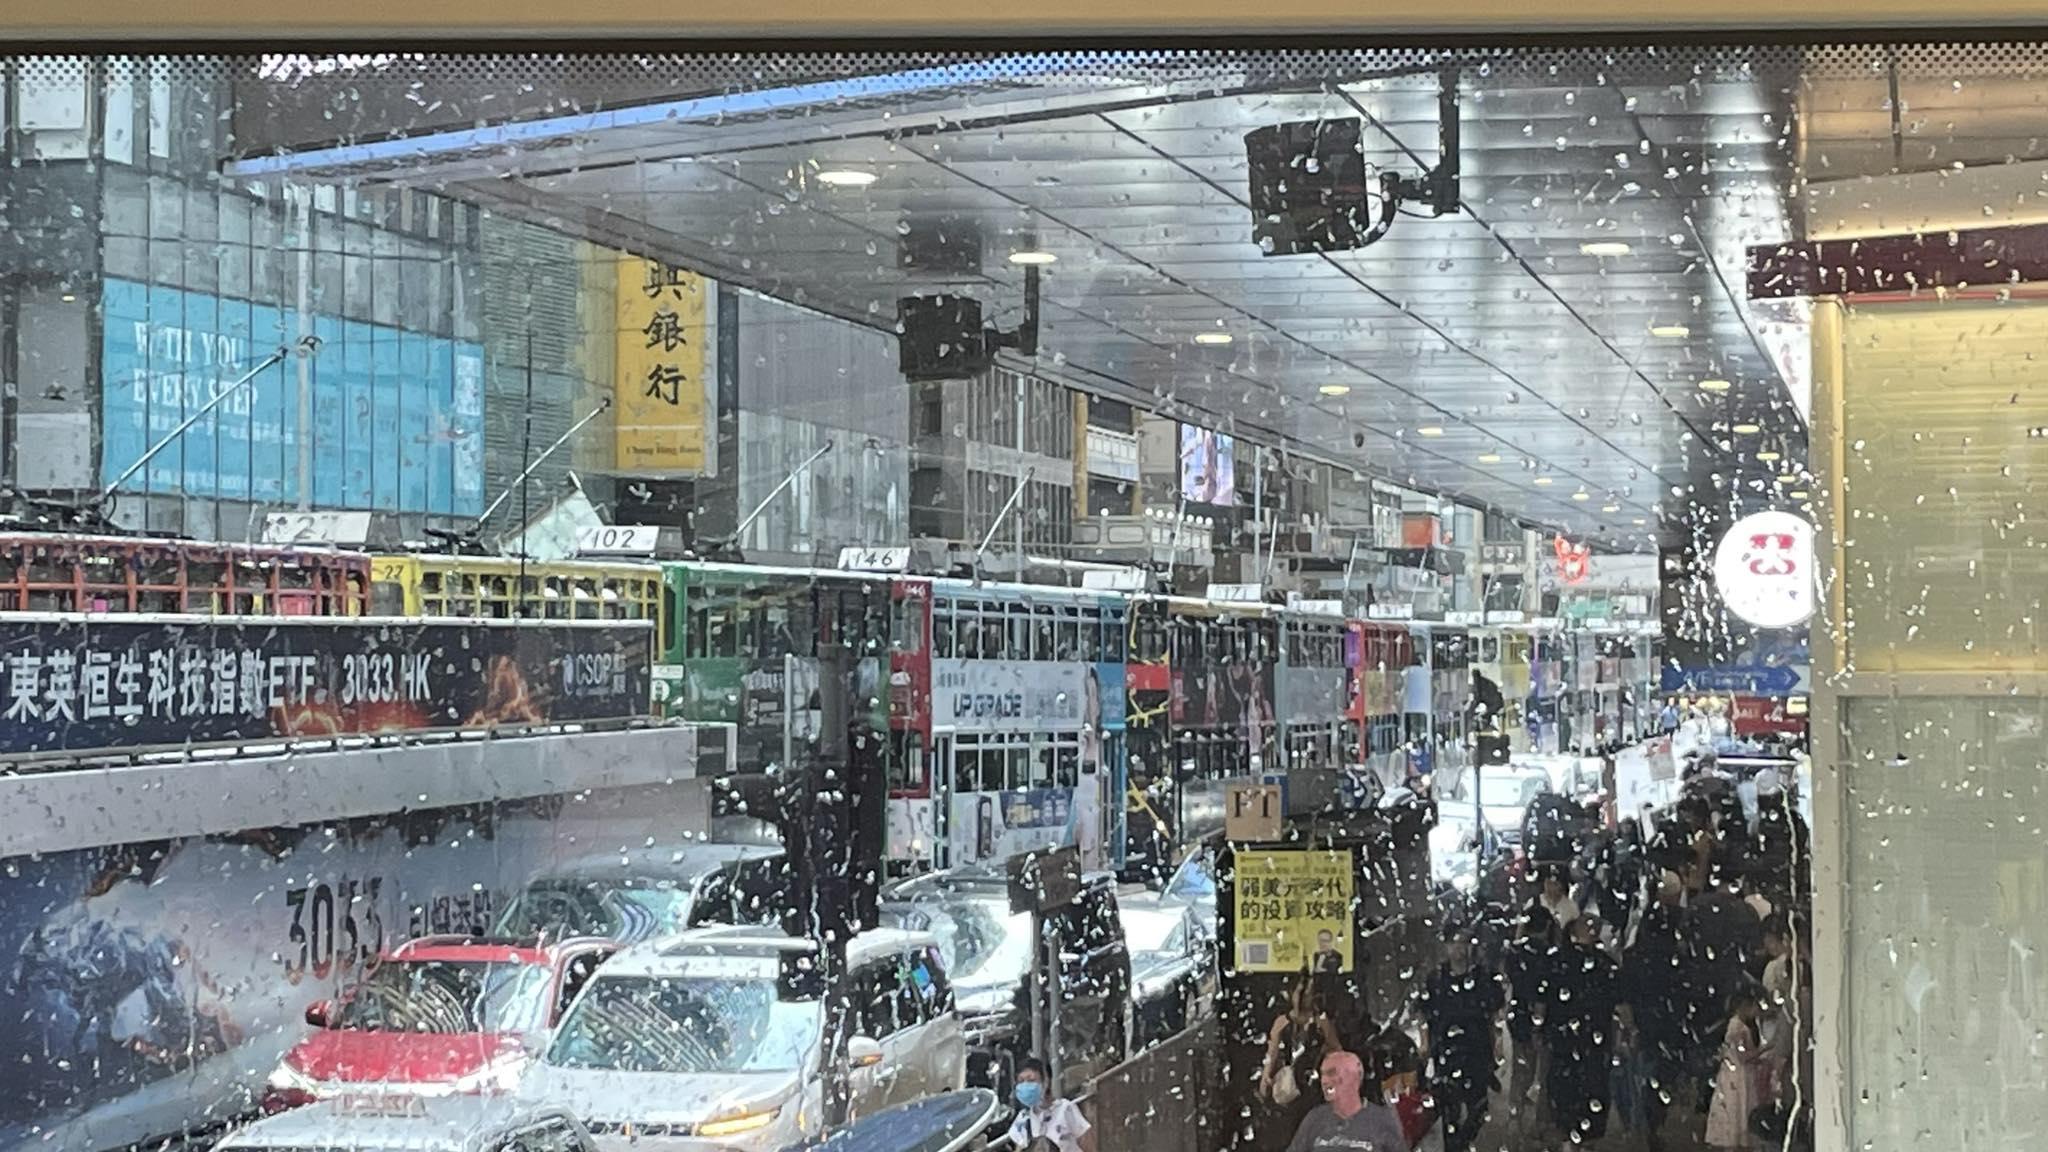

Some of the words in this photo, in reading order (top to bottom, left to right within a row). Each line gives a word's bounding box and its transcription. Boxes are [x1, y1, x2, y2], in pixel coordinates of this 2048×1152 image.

[201, 332, 244, 369] YOU
[594, 529, 635, 548] 102
[856, 550, 893, 567] 146
[342, 653, 432, 704] 3033.HK
[576, 653, 611, 685] CSOP
